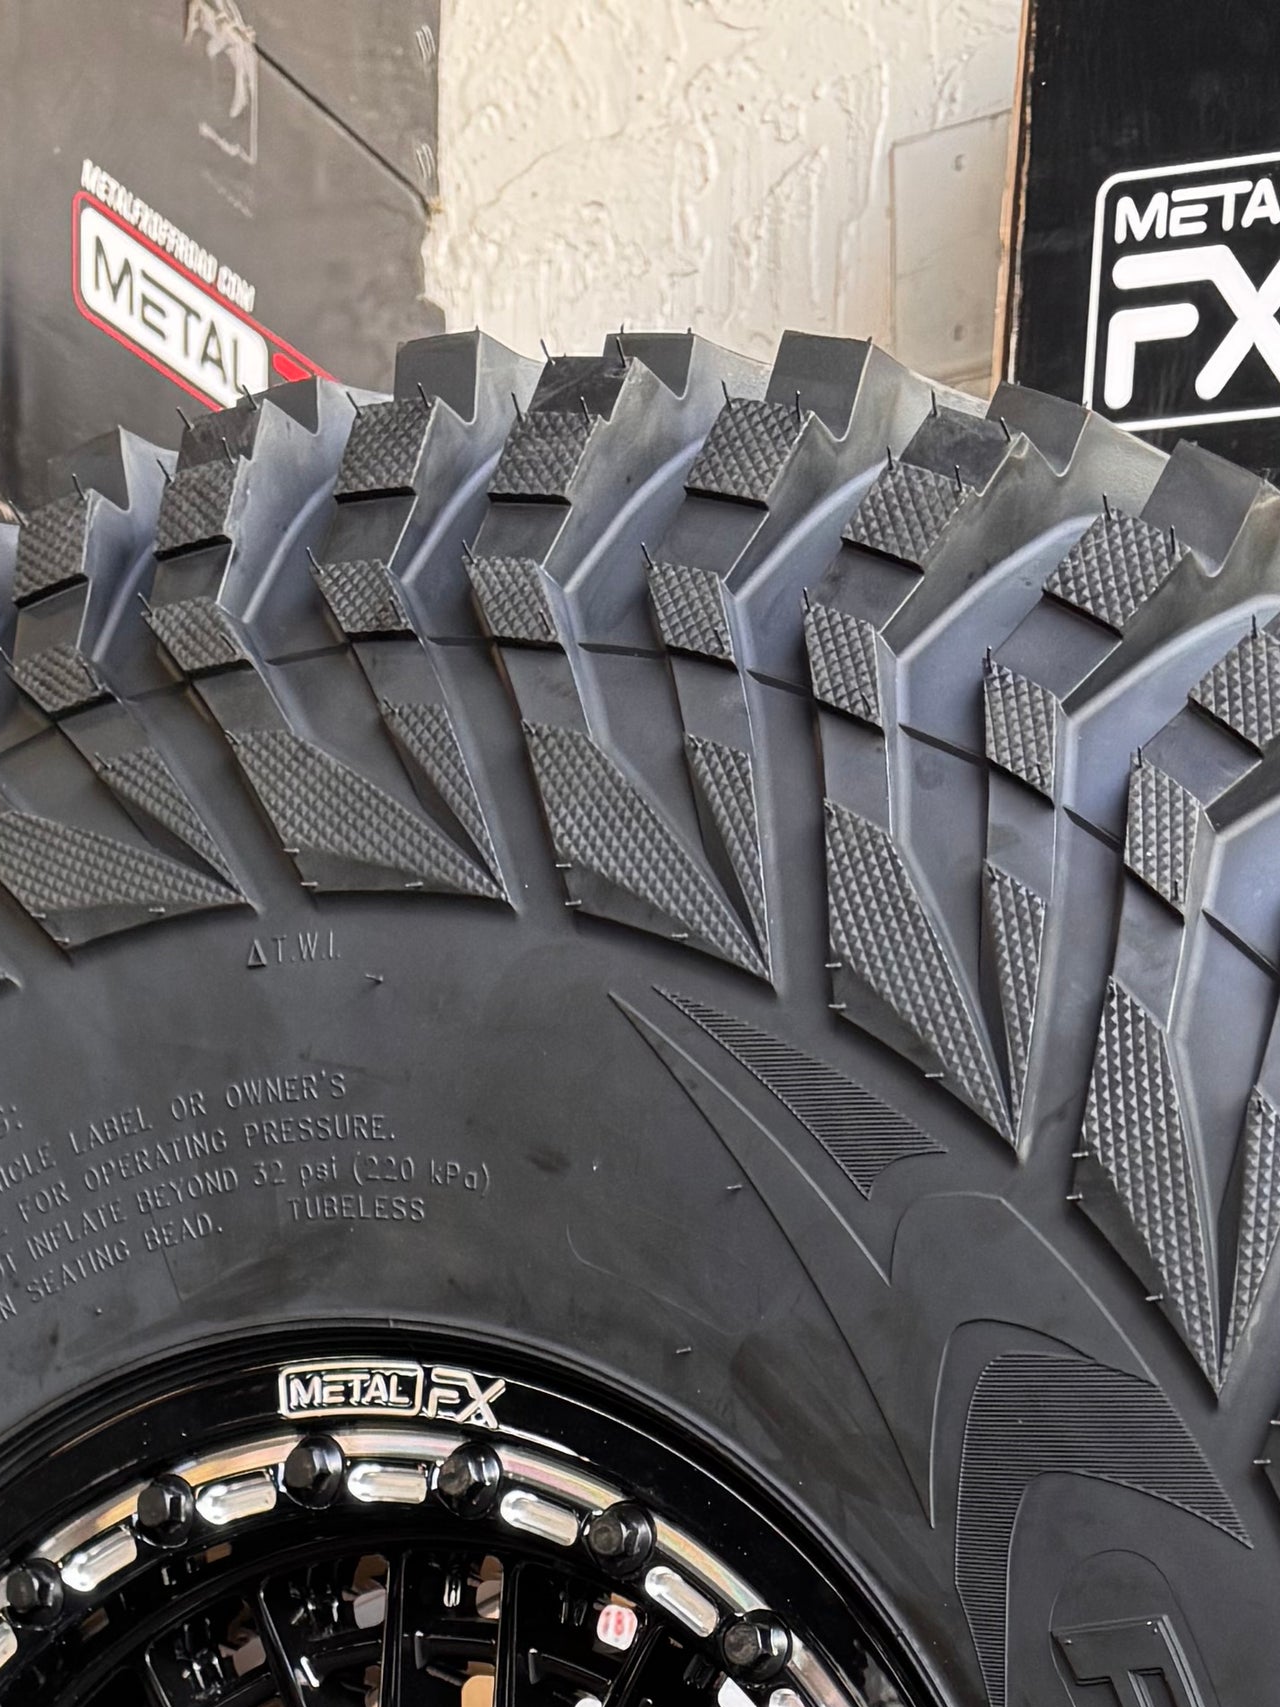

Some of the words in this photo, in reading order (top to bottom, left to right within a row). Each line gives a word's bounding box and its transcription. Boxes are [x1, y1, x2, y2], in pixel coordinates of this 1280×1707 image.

[95, 235, 245, 396] METAL
[69, 1105, 153, 1155] LABEL
[171, 1090, 207, 1121] OR
[225, 1069, 347, 1109] OWNER'S
[18, 1181, 70, 1224] FOR
[83, 1129, 227, 1192] OPERATING
[244, 1113, 396, 1148] PRESSURE.
[25, 1198, 128, 1261] INFLATE
[136, 1167, 239, 1215] BEYOND
[253, 1158, 287, 1187] 32
[299, 1155, 338, 1189] psi
[353, 1151, 416, 1187] (220
[430, 1157, 492, 1198] kPa)
[288, 1194, 426, 1222] TUBELESS
[26, 1239, 131, 1302] SEATING
[143, 1212, 223, 1252] BEAD.
[289, 1371, 410, 1408] METAL
[431, 1366, 506, 1430] FX
